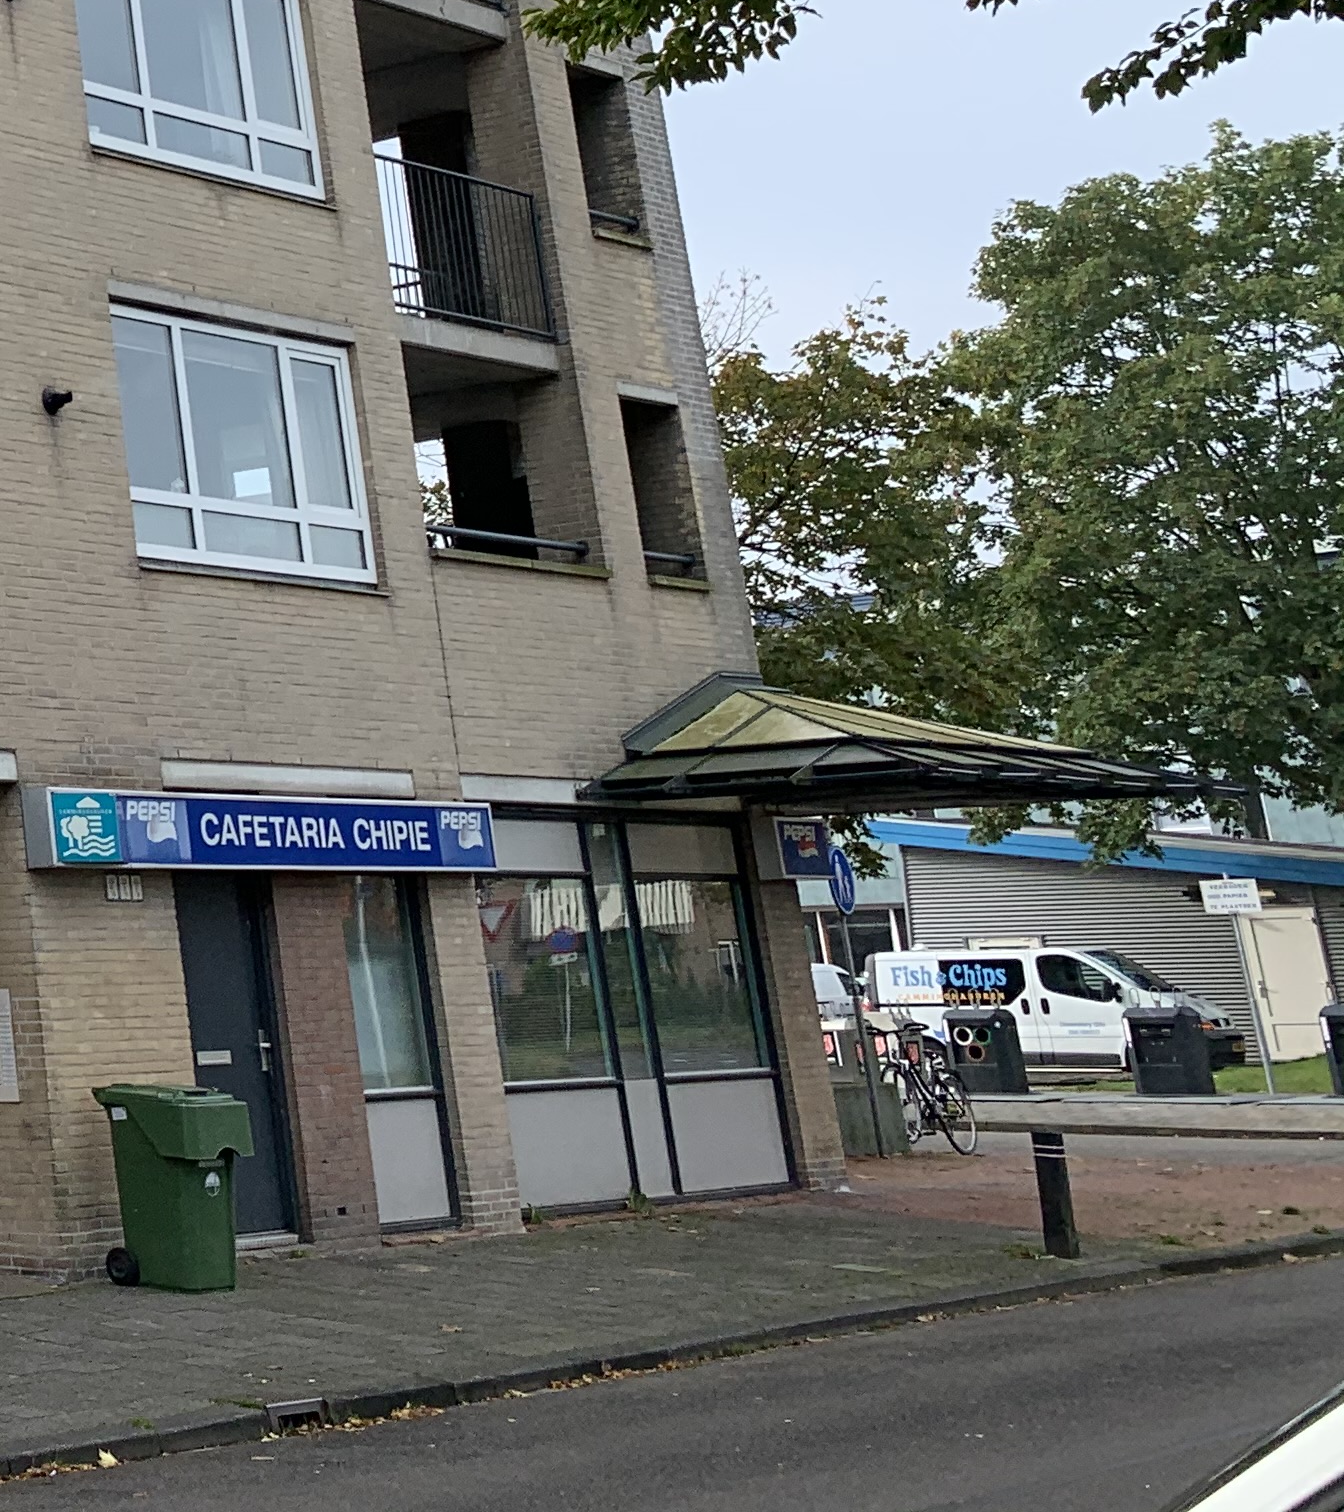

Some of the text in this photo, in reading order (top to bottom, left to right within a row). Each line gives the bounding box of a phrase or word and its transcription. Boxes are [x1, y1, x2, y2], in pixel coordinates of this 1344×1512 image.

[126, 800, 176, 823] PEPSI
[440, 811, 482, 831] PEPSI
[200, 812, 431, 852] CAFETARIA CHIPIE
[783, 824, 816, 842] PEPSI
[890, 963, 1007, 991] Fish & Chips
